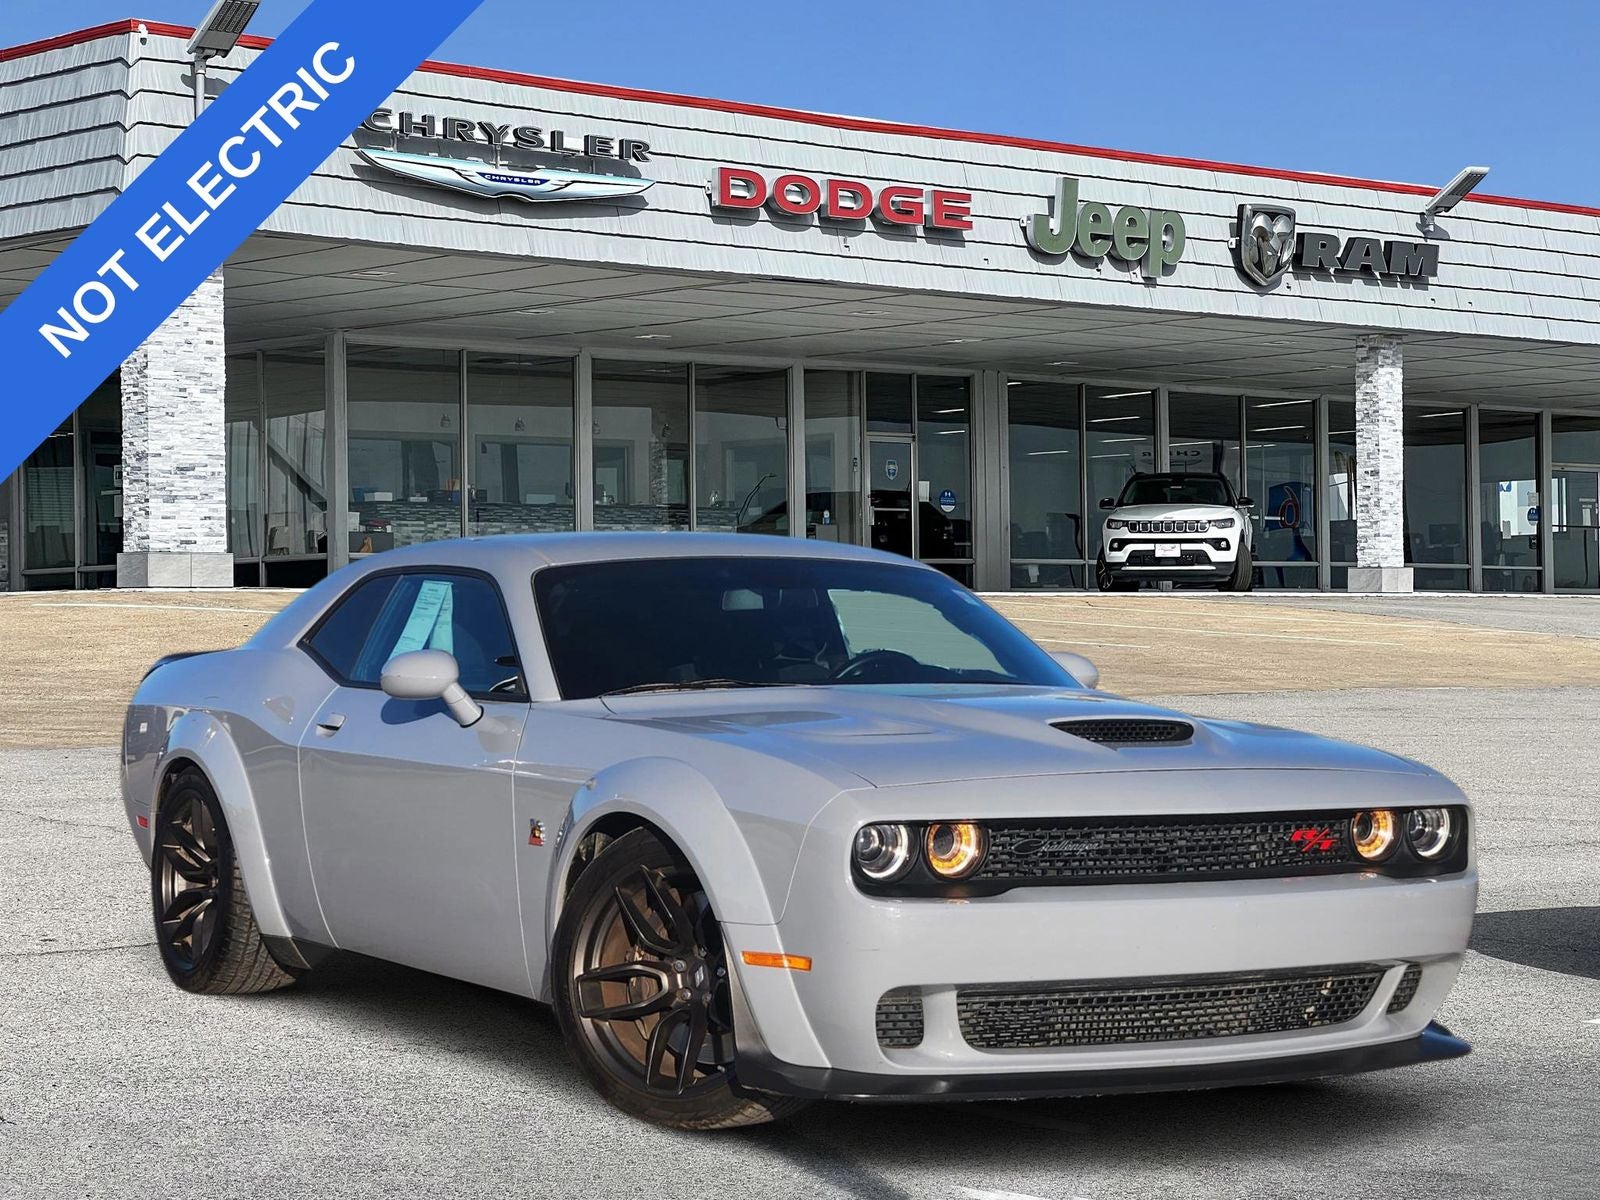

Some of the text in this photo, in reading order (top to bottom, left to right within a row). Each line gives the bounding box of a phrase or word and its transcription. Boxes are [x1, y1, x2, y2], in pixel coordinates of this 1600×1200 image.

[363, 108, 652, 162] CHRYSLER
[484, 174, 541, 185] CHRYSLER
[712, 166, 974, 231] DODGE
[1027, 177, 1187, 278] Jeep
[1299, 231, 1440, 277] RAM
[1290, 827, 1337, 853] R/T
